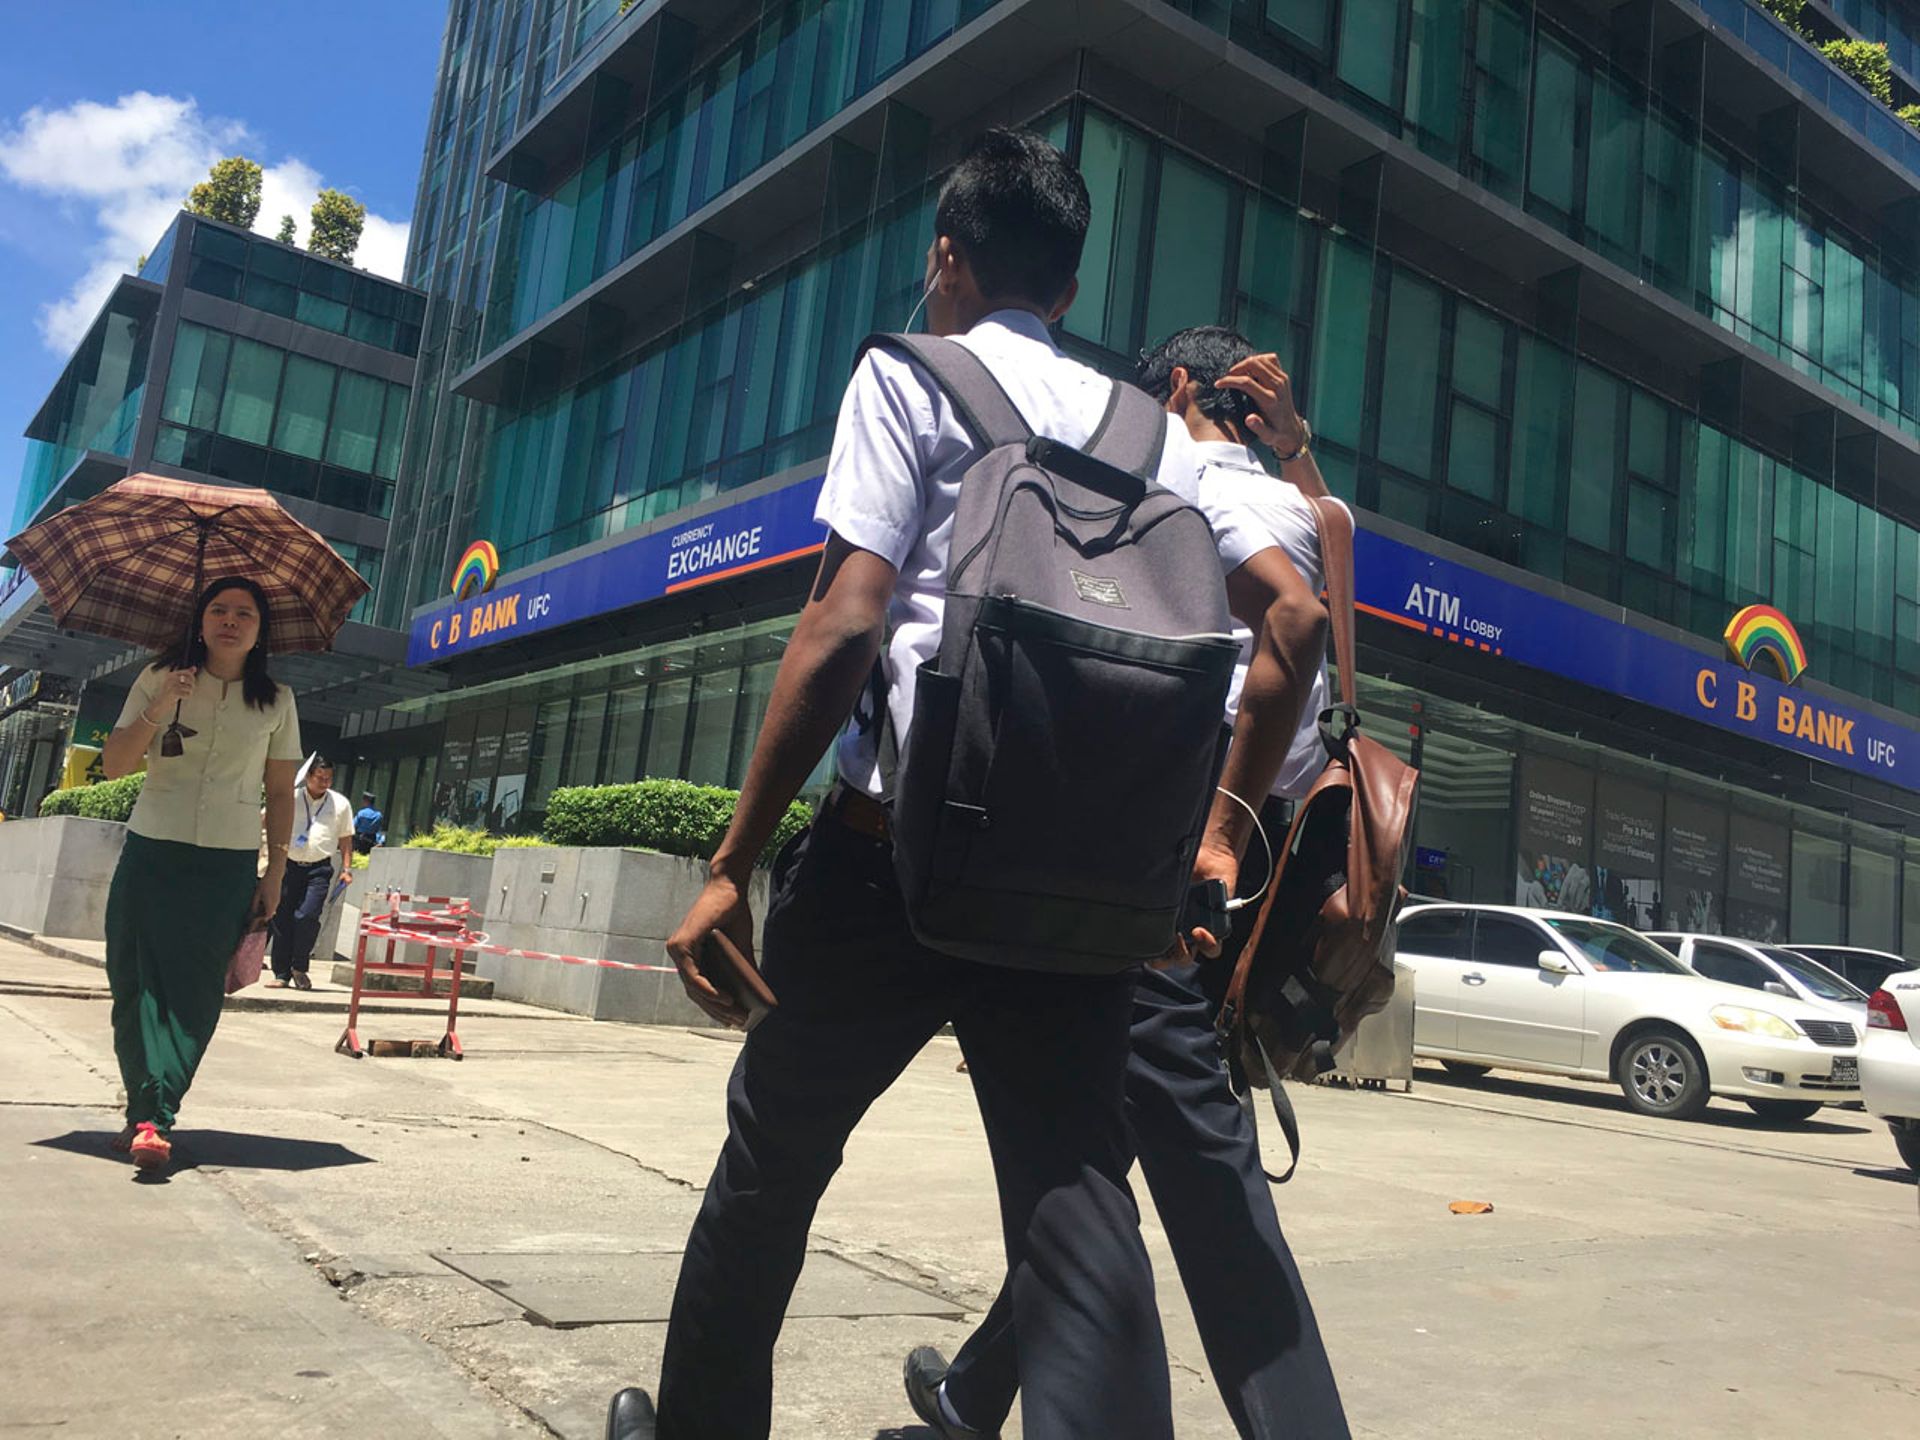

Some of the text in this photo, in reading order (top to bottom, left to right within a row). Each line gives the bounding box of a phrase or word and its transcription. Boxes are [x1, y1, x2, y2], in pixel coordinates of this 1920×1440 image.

[667, 527, 763, 579] EXCHANGE
[672, 523, 714, 548] CURRENCY
[469, 593, 520, 637] BANK
[527, 593, 551, 621] UFC
[1404, 582, 1503, 641] ATM LOBBY
[1777, 696, 1856, 755] BANK
[1867, 737, 1896, 768] UFC
